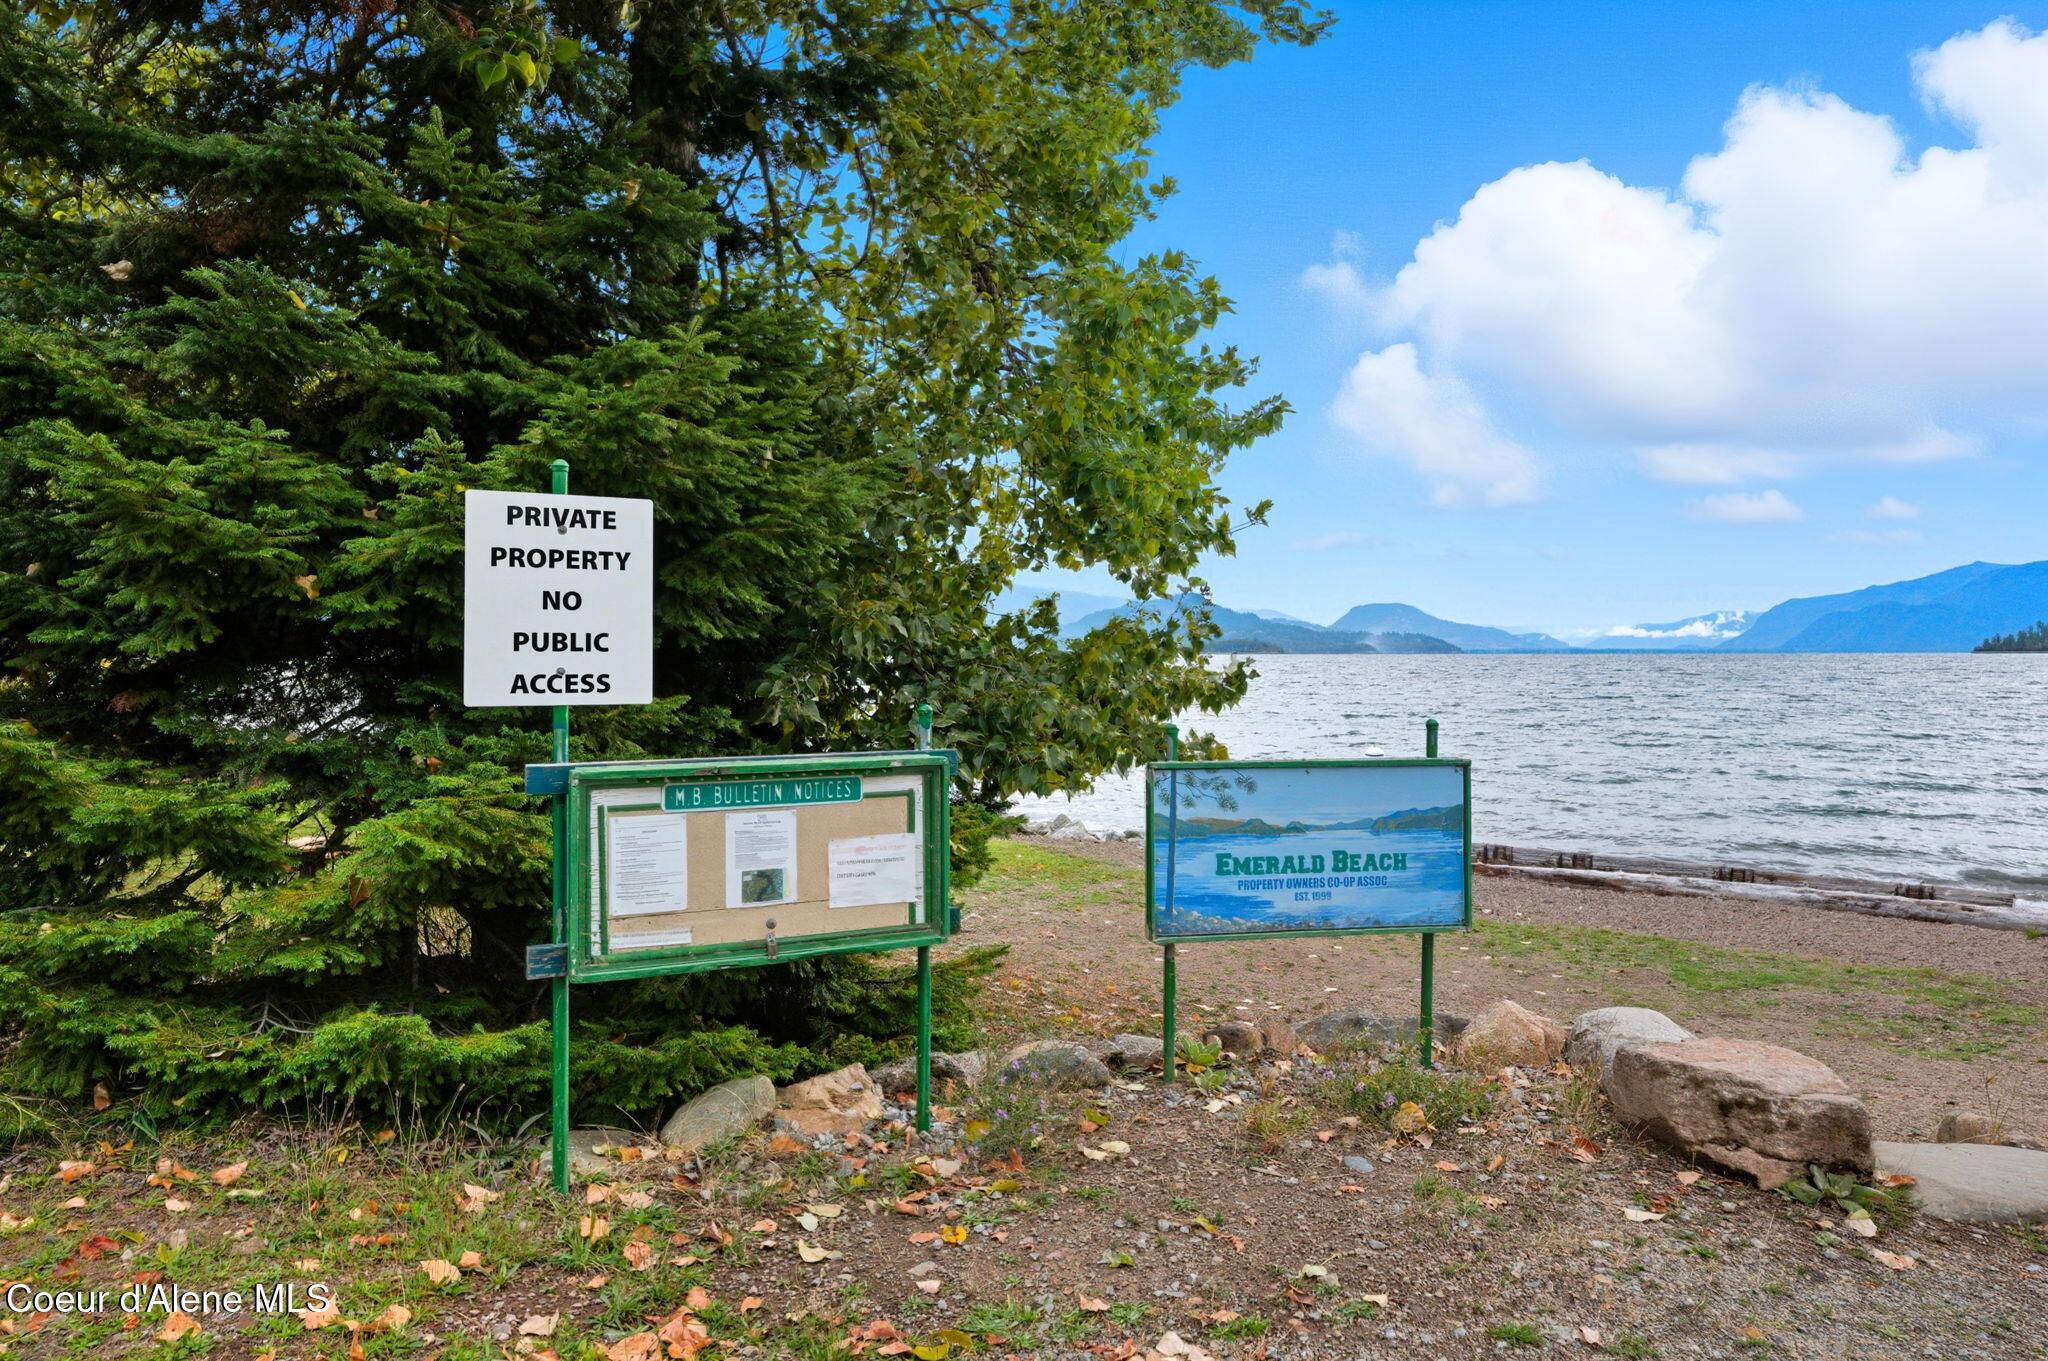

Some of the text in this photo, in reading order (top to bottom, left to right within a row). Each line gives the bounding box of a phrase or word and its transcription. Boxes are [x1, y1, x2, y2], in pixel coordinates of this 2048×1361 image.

[507, 505, 617, 530] PRIVATE
[490, 547, 631, 571] PROPERTY
[542, 590, 582, 611] NO
[513, 631, 610, 652] PUBLIC
[510, 673, 611, 694] ACCESS
[714, 784, 783, 805] BULLETIN
[794, 780, 852, 800] NOTICES
[1215, 850, 1408, 876] EMERALD BEACH
[1237, 875, 1388, 891] PROPERTY OWNERS CO-OP ASSOC
